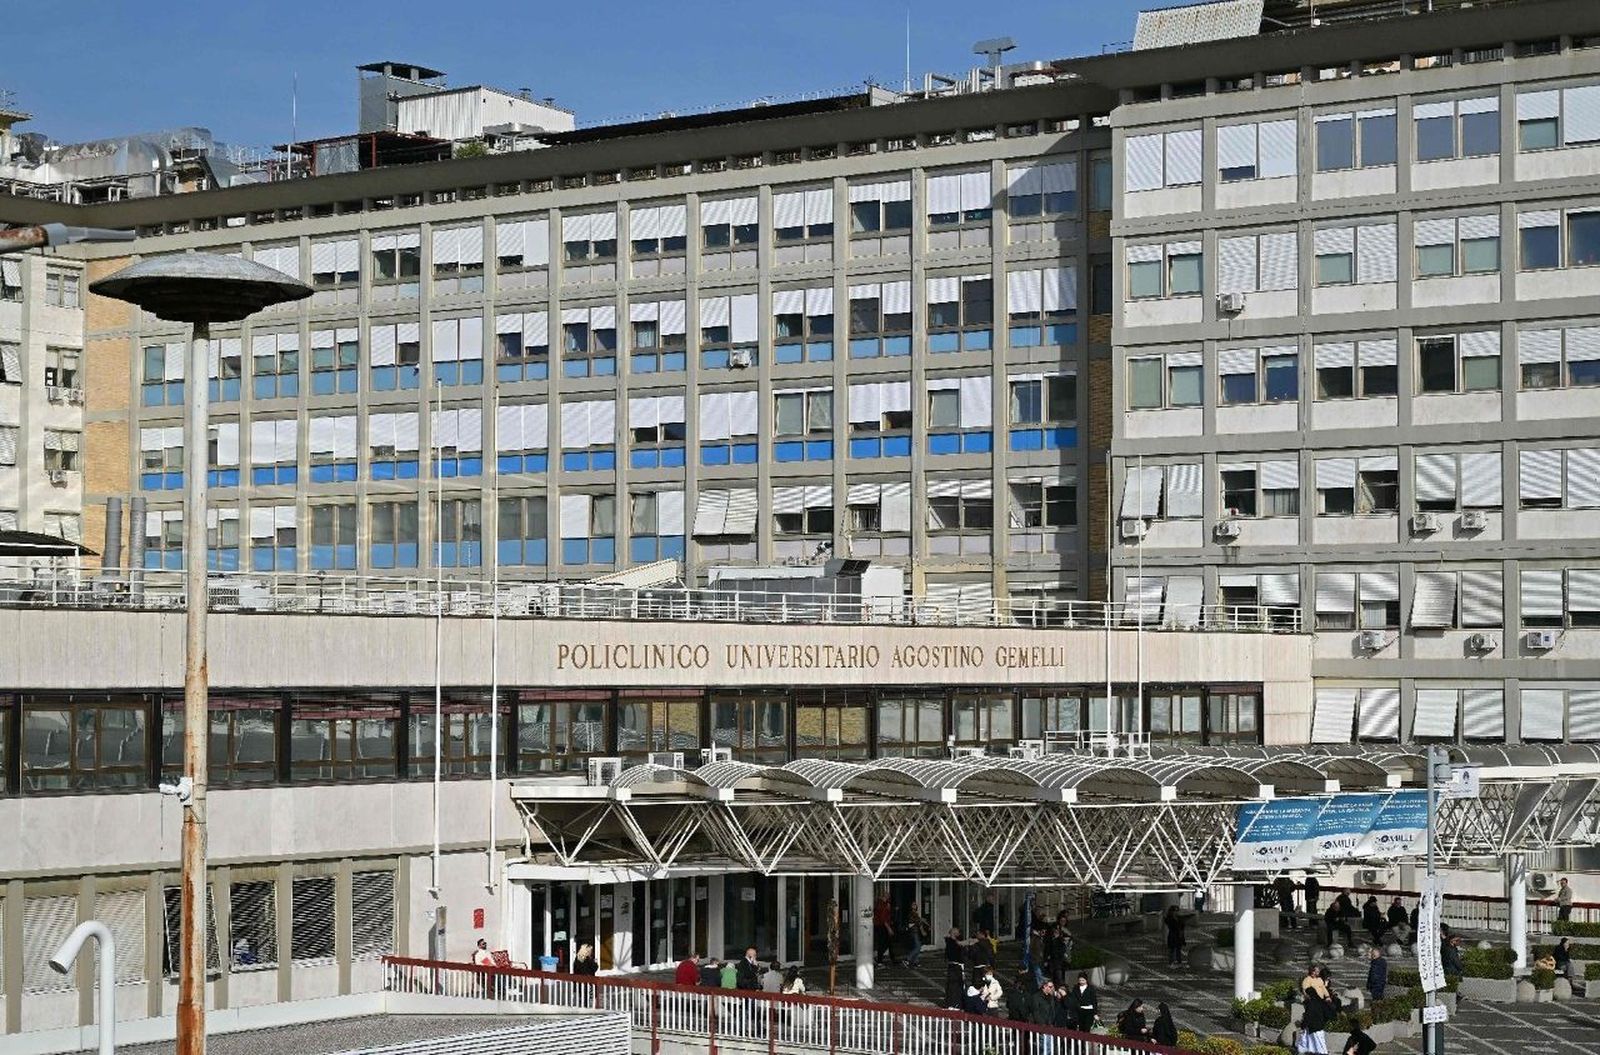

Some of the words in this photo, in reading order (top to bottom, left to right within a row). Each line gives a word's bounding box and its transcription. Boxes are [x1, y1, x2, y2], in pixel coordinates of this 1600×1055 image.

[557, 644, 710, 669] POLICLINICO
[726, 644, 880, 669] UNIVERSITARIO
[891, 645, 984, 668] AGOSTINO
[996, 645, 1066, 668] GEMELLI
